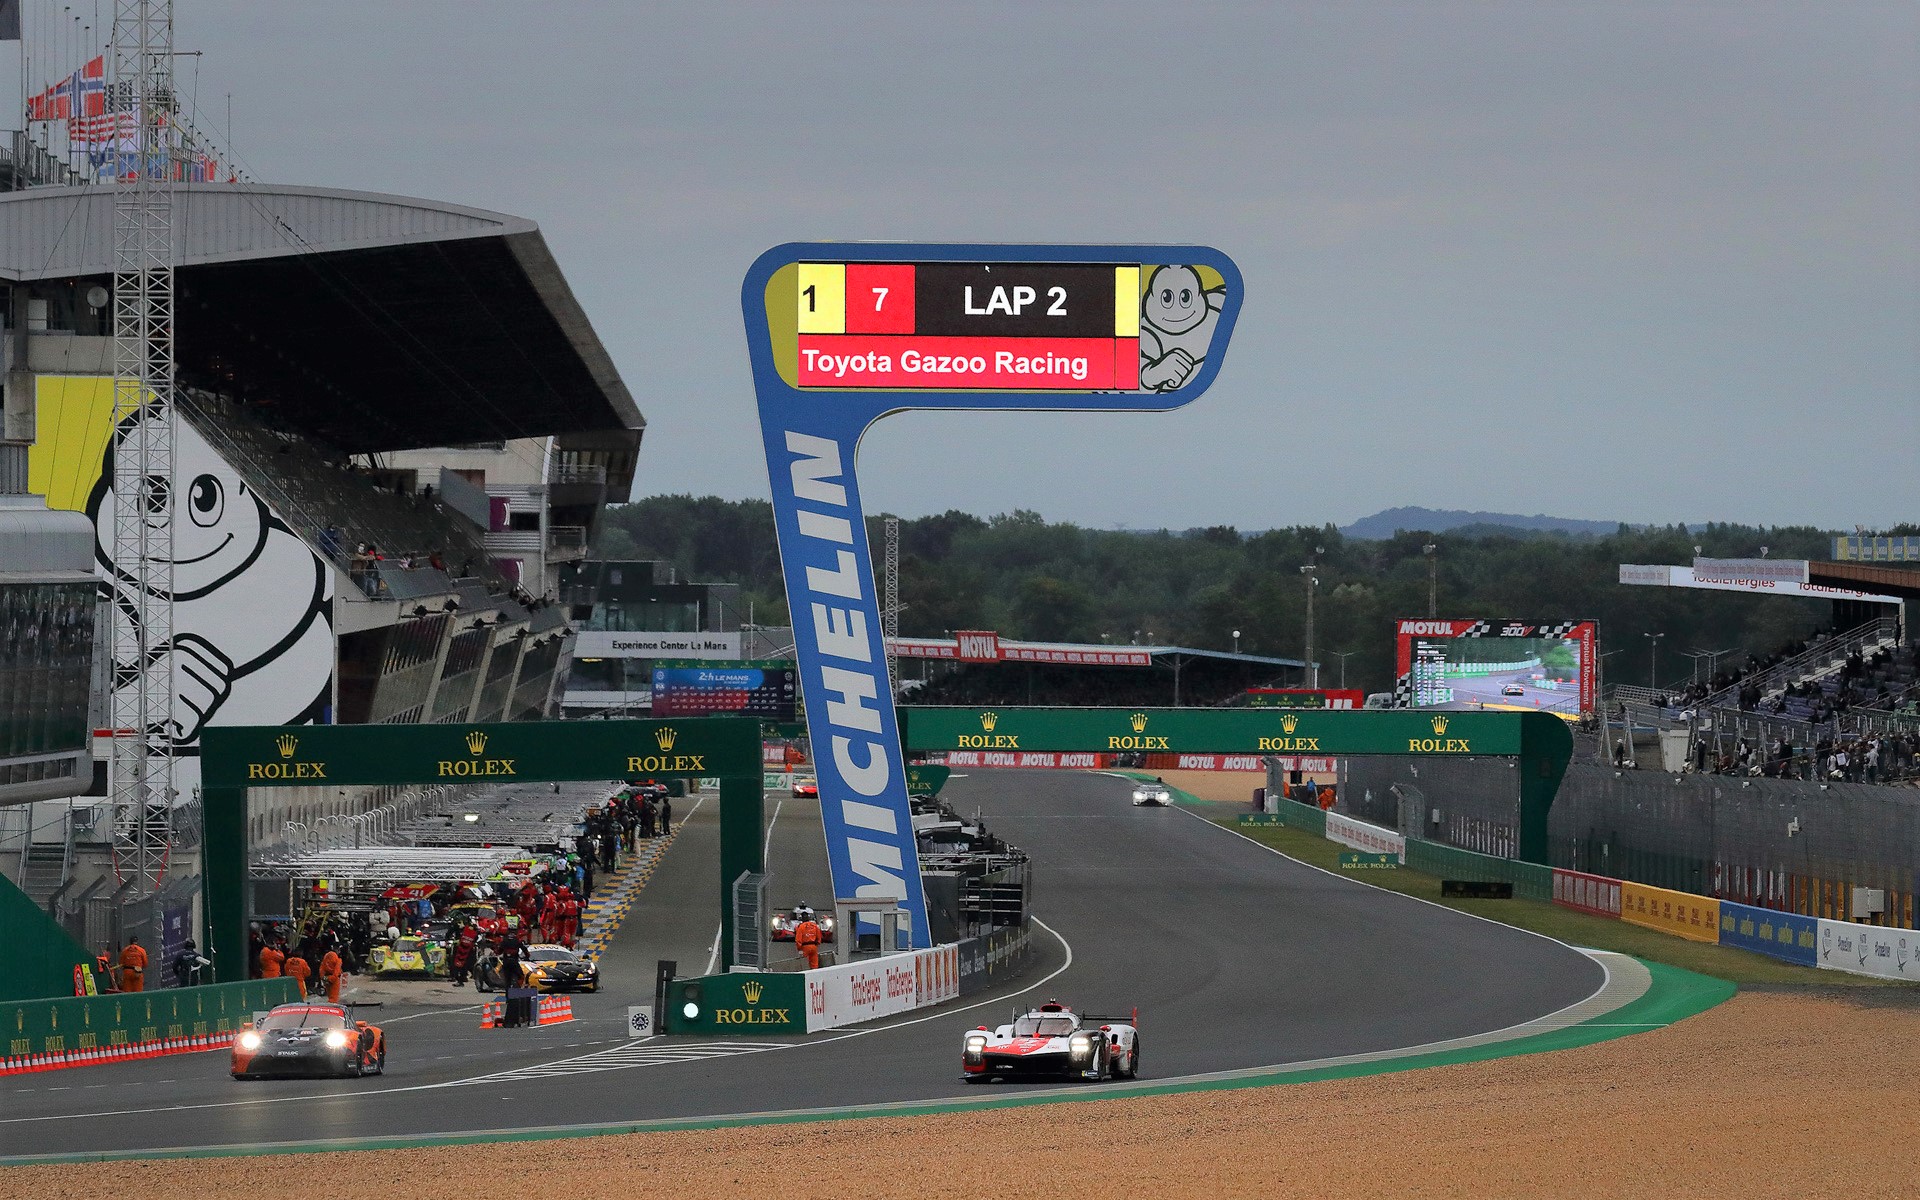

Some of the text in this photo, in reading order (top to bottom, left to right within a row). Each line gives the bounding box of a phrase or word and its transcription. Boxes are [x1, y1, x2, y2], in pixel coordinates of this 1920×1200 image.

[802, 285, 1067, 316] 1 7 LAP 2
[802, 349, 1088, 380] Toyota Gazoo Racing
[1400, 621, 1453, 635] MOTUL
[1500, 626, 1535, 637] 300V
[612, 640, 658, 651] Experience
[660, 640, 688, 650] Center
[960, 636, 997, 659] MOTUL
[1583, 629, 1592, 665] Perpetual
[784, 430, 910, 932] MICHELIN
[958, 735, 1470, 753] ROLEX ROLEX ROLEX ROLEX
[248, 755, 705, 779] ROLEX ROLEX ROLEX
[949, 751, 979, 765] MOTUL
[984, 752, 1015, 766] MOTUL
[1021, 753, 1055, 767] MOTUL
[1060, 754, 1095, 767] MOTUL
[1178, 755, 1215, 768] MOTUL
[1223, 756, 1257, 769] MOTUL
[907, 782, 932, 790] OLEX
[271, 1007, 340, 1015] PORSCHE
[716, 1008, 790, 1024] ROLEX
